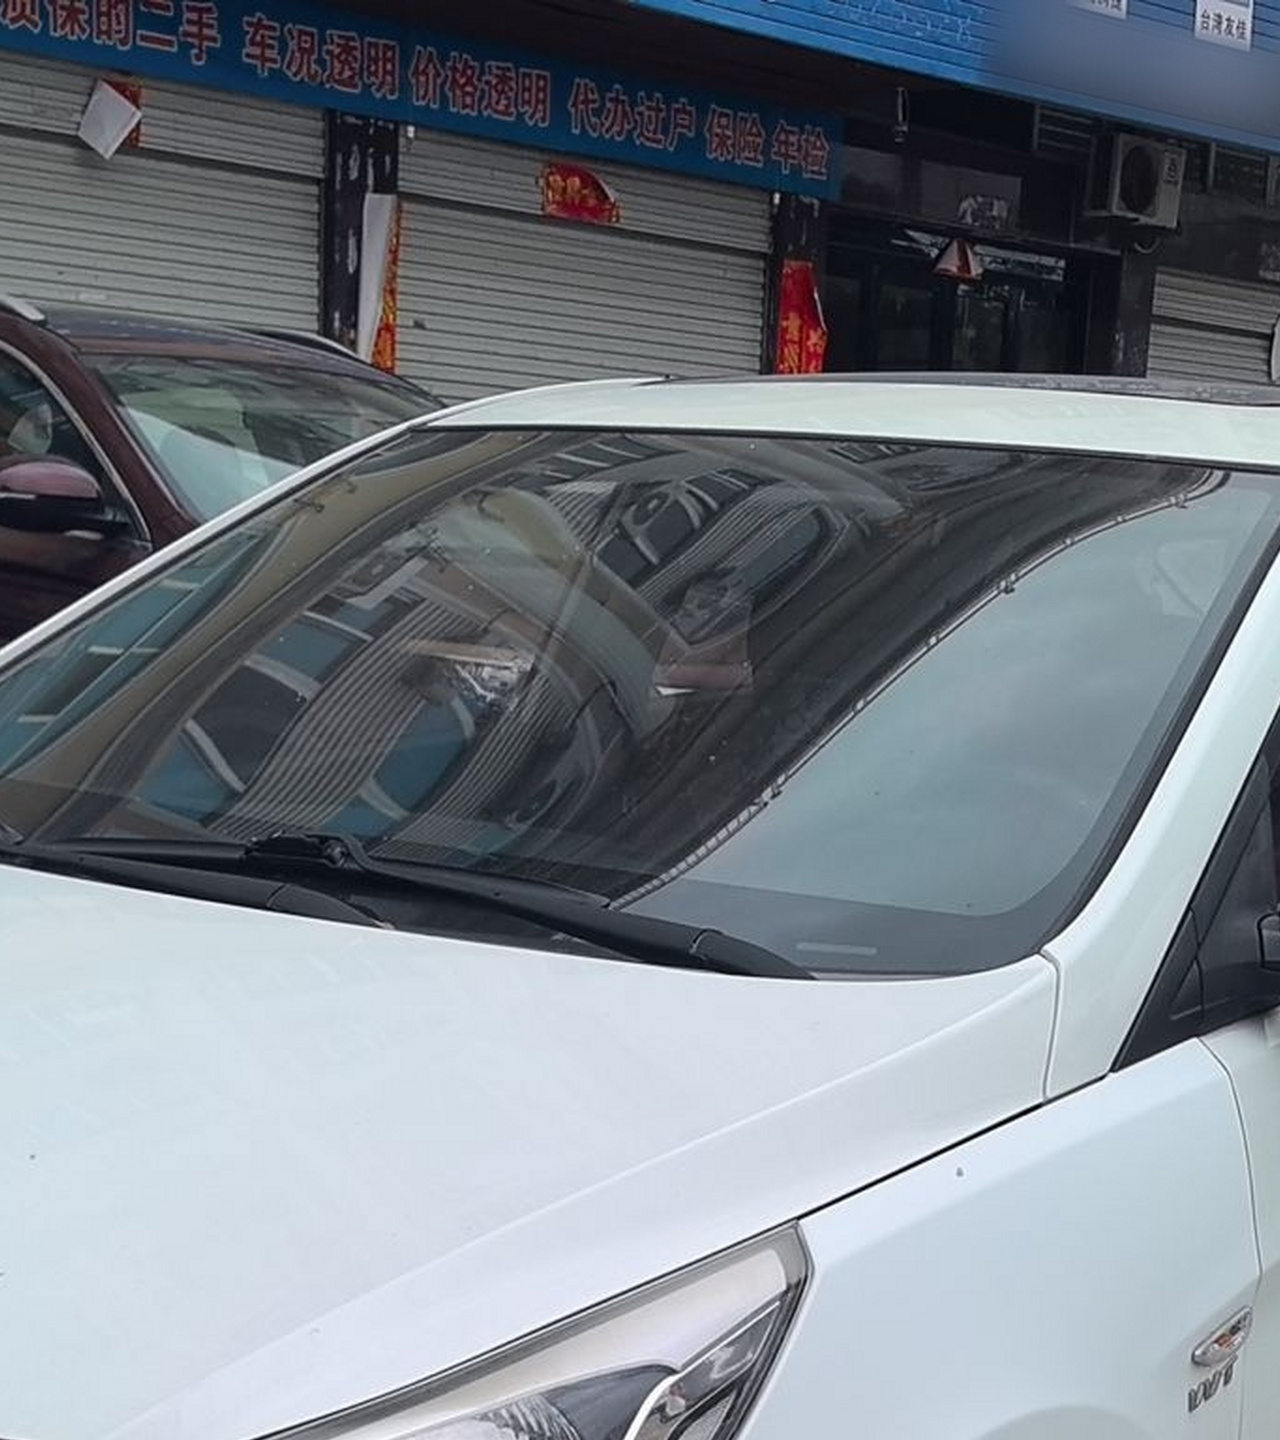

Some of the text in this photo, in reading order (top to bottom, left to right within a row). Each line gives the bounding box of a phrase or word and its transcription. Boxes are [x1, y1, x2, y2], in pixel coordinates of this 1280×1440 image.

[242, 14, 400, 99] 车况透明
[409, 45, 550, 128] 价格透明
[570, 77, 696, 152] 代办过户
[704, 105, 764, 168] 保险
[772, 119, 832, 181] 年检
